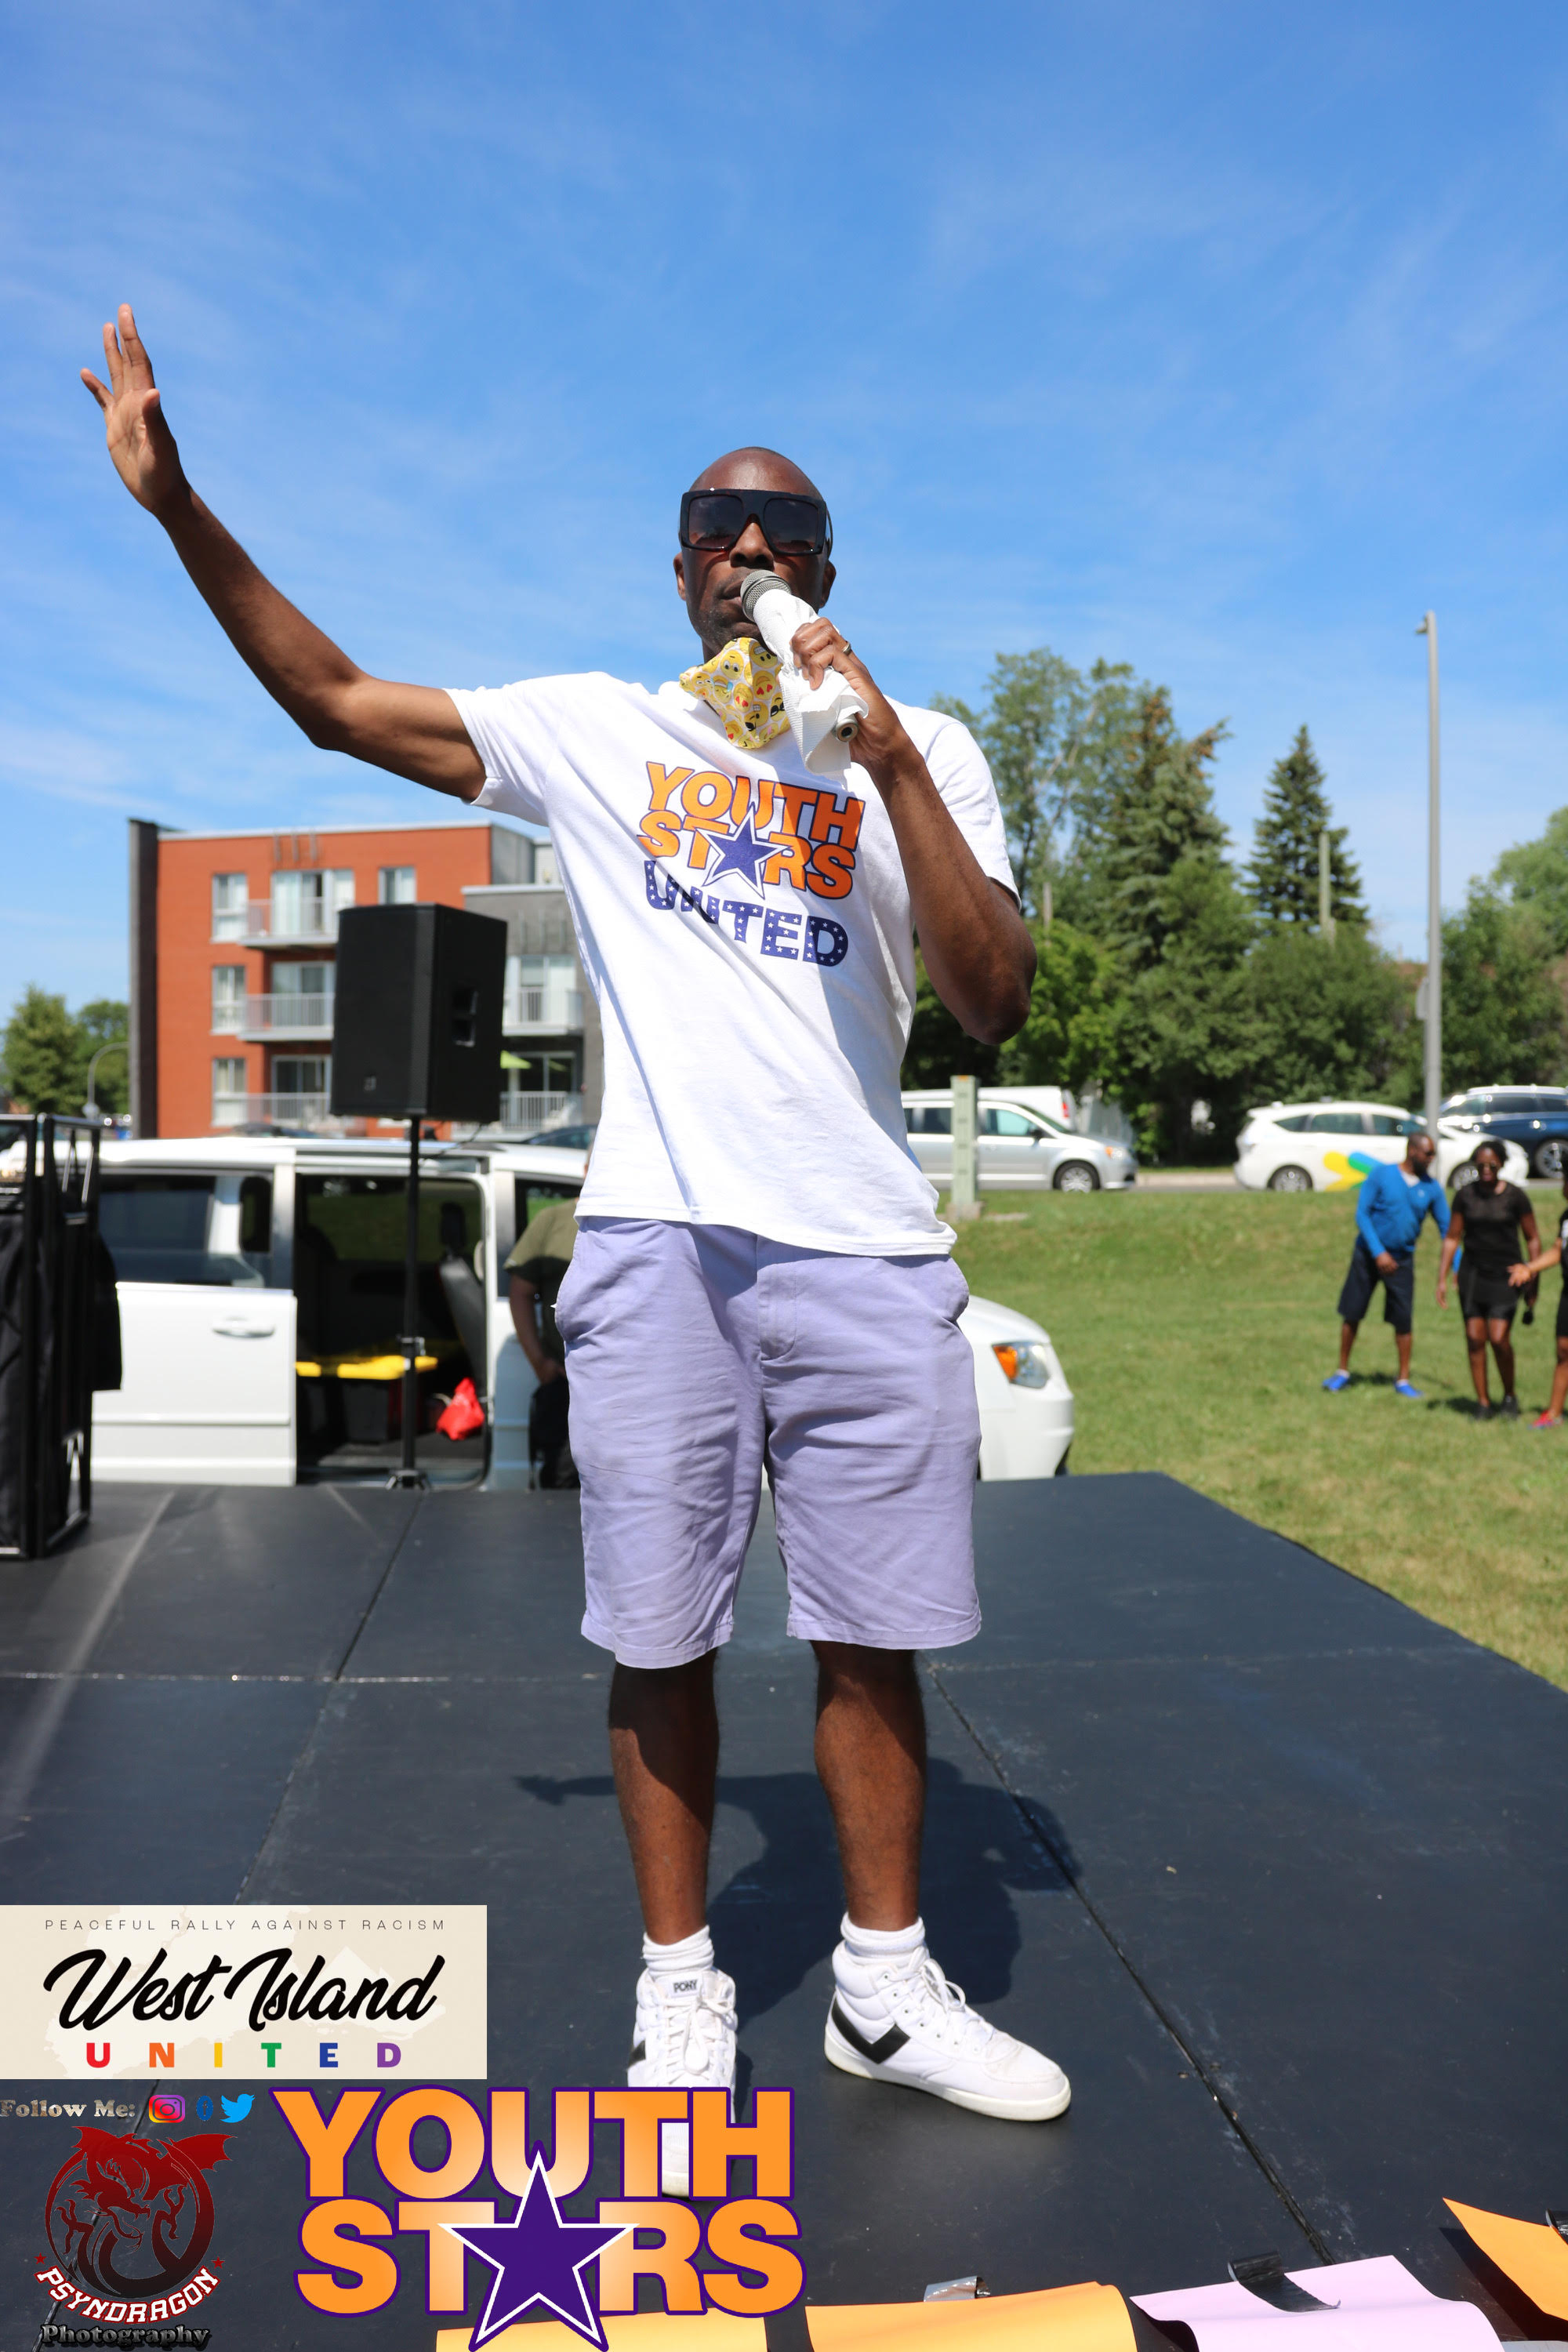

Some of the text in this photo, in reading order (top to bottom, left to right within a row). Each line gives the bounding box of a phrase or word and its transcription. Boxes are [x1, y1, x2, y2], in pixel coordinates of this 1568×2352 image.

[646, 761, 866, 851] YOUTH
[644, 860, 849, 967] UNITED
[673, 1979, 698, 1993] PONY
